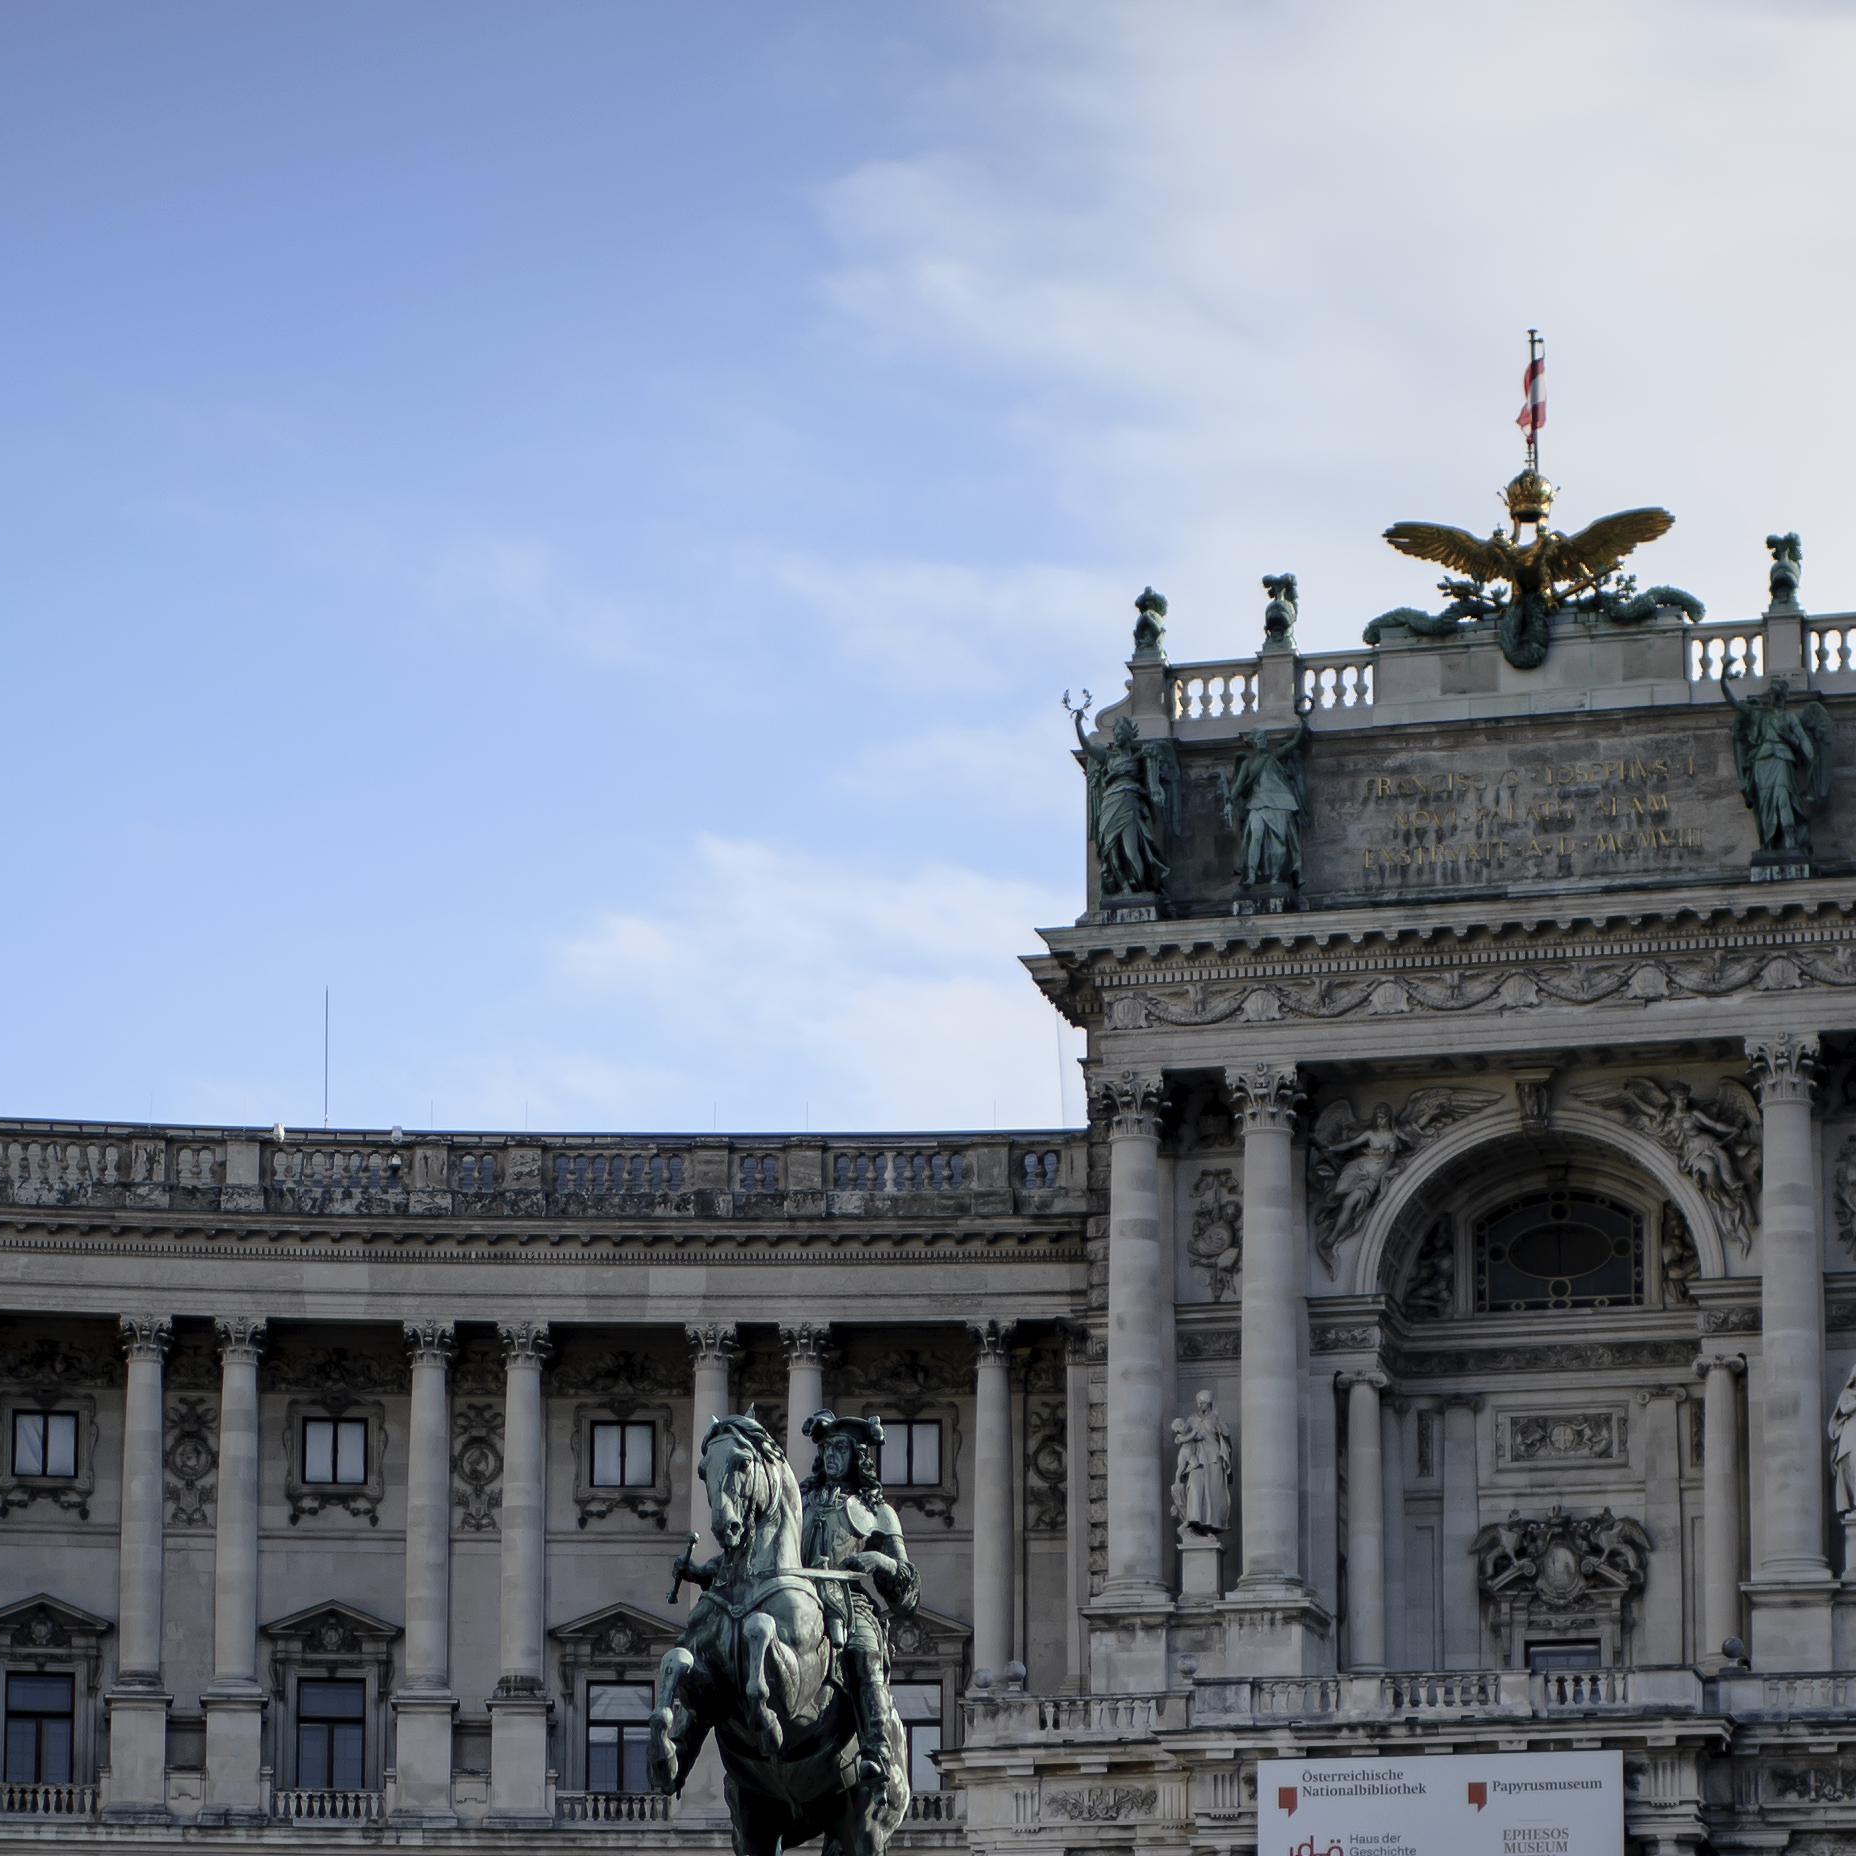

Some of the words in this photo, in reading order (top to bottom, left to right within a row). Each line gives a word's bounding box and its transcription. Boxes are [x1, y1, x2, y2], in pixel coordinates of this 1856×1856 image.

[1528, 837, 1544, 858] A
[1558, 835, 1577, 856] D
[1301, 1768, 1404, 1784] Österreichische
[1301, 1780, 1427, 1798] Nationalbibliothek
[1492, 1777, 1603, 1794] Papyrusmuseum
[1349, 1833, 1380, 1845] Haus
[1382, 1832, 1402, 1844] der
[1502, 1828, 1570, 1842] EPHESOS
[1503, 1840, 1569, 1855] MUSEUM
